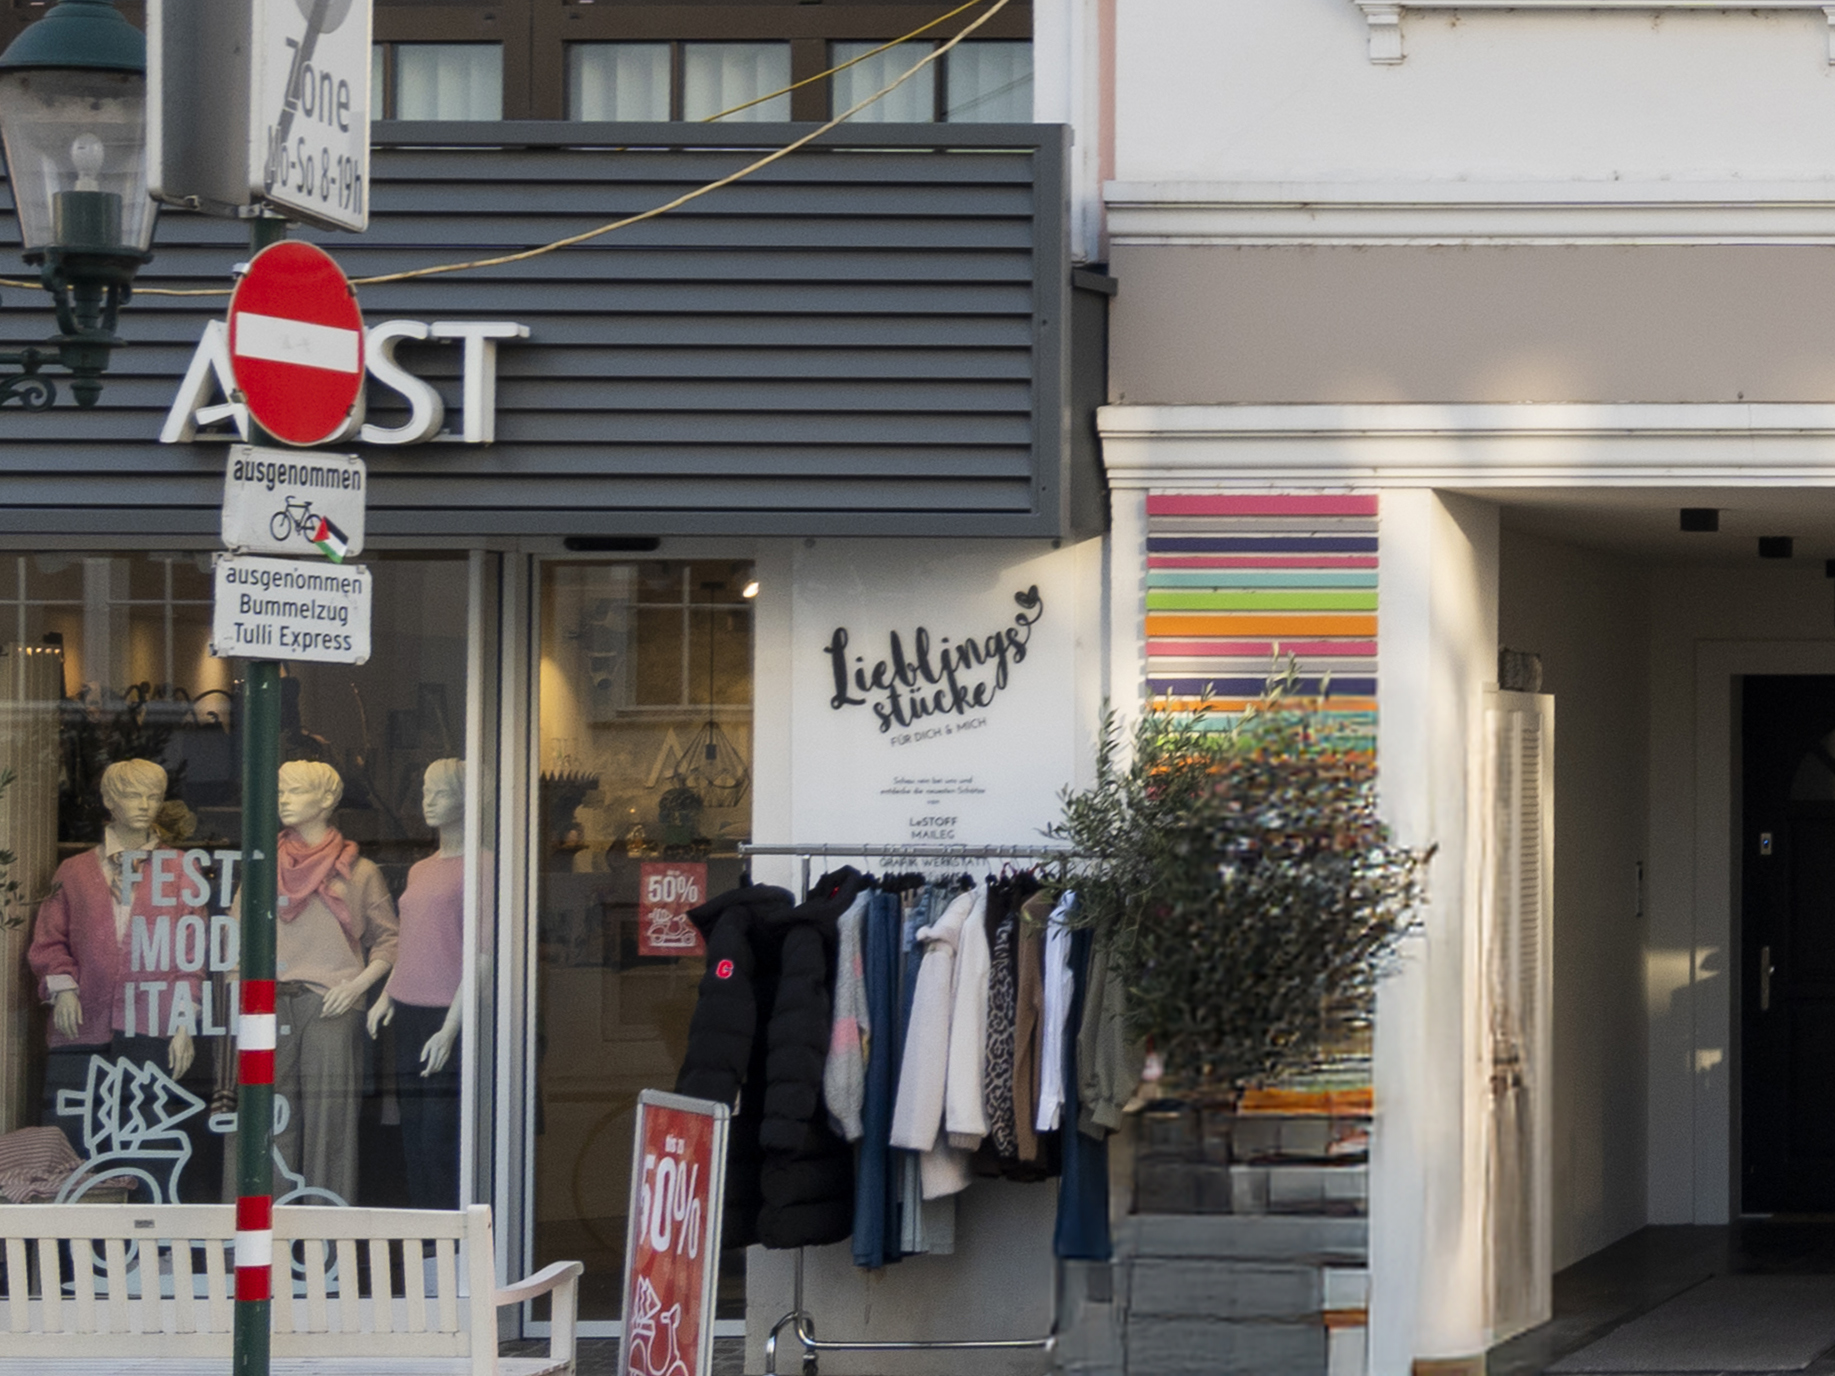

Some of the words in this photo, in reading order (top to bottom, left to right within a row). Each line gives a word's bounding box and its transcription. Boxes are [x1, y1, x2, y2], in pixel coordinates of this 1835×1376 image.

[284, 36, 350, 133] Zone
[320, 147, 362, 215] 8-19h
[160, 319, 531, 444] AST
[233, 457, 361, 491] ausgenommen
[225, 566, 363, 594] ausgenommen
[239, 593, 349, 626] Bummelzug
[234, 622, 273, 646] Tulli
[279, 626, 352, 652] Express
[823, 625, 1032, 710] Lieblings
[872, 682, 998, 733] stücke
[890, 731, 912, 748] FÜR
[914, 727, 942, 742] DICH
[956, 717, 988, 734] MICH
[909, 817, 958, 827] LeSTOFF
[911, 829, 956, 840] MAILEG
[648, 875, 698, 903] 50%
